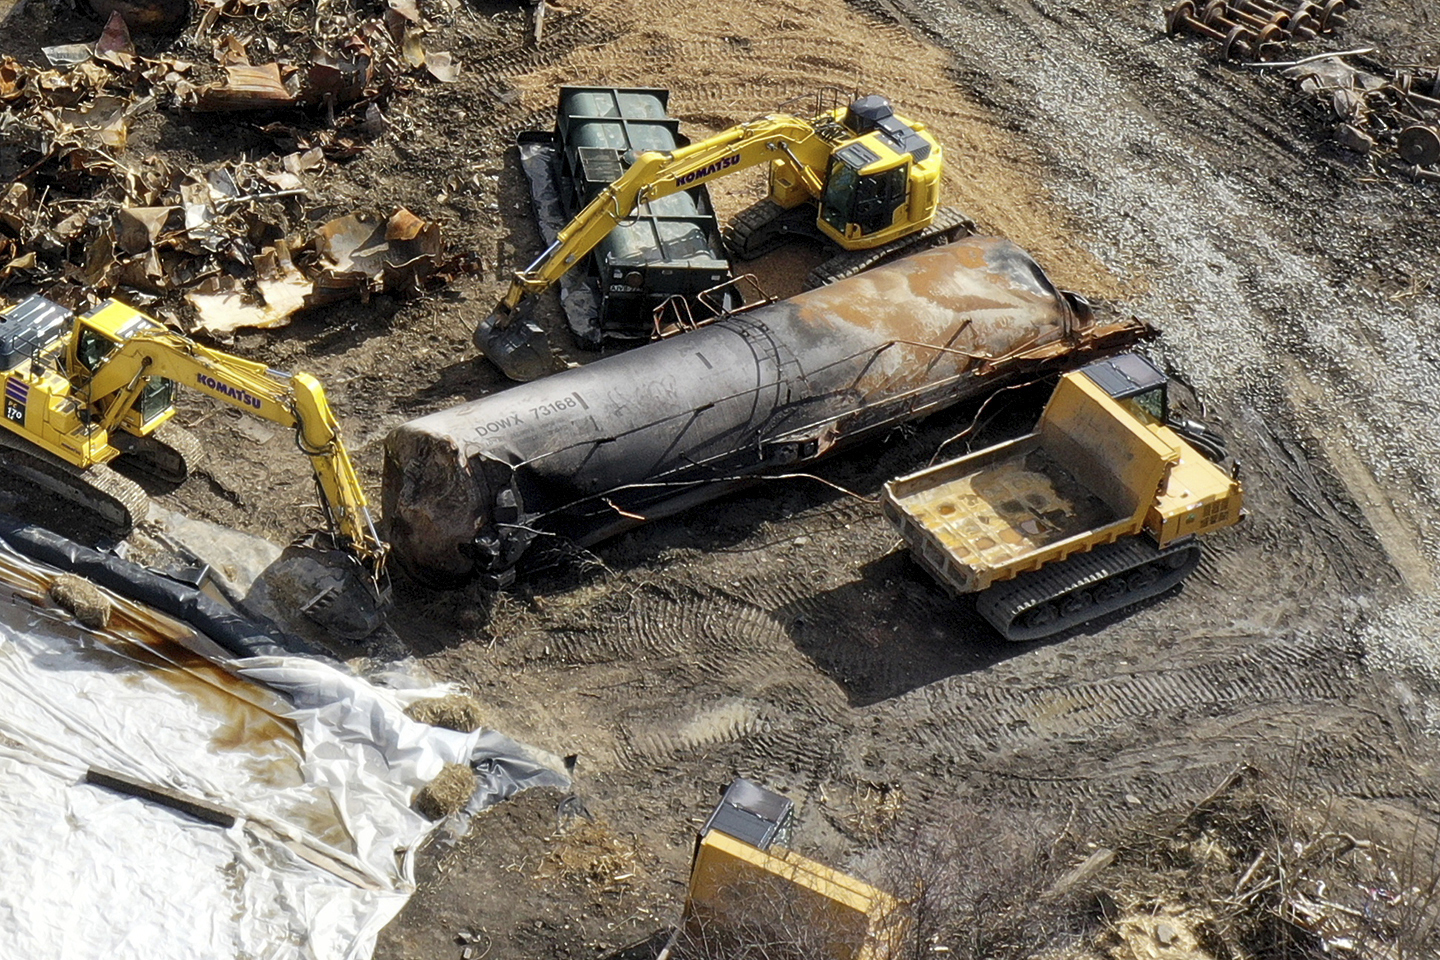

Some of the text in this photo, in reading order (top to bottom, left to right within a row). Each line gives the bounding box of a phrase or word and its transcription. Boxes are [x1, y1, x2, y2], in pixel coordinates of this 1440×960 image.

[675, 153, 741, 187] KOMATSU
[197, 372, 261, 409] KOMATSU
[7, 407, 22, 419] 170
[475, 413, 524, 437] DOWX
[529, 396, 577, 420] 73168
